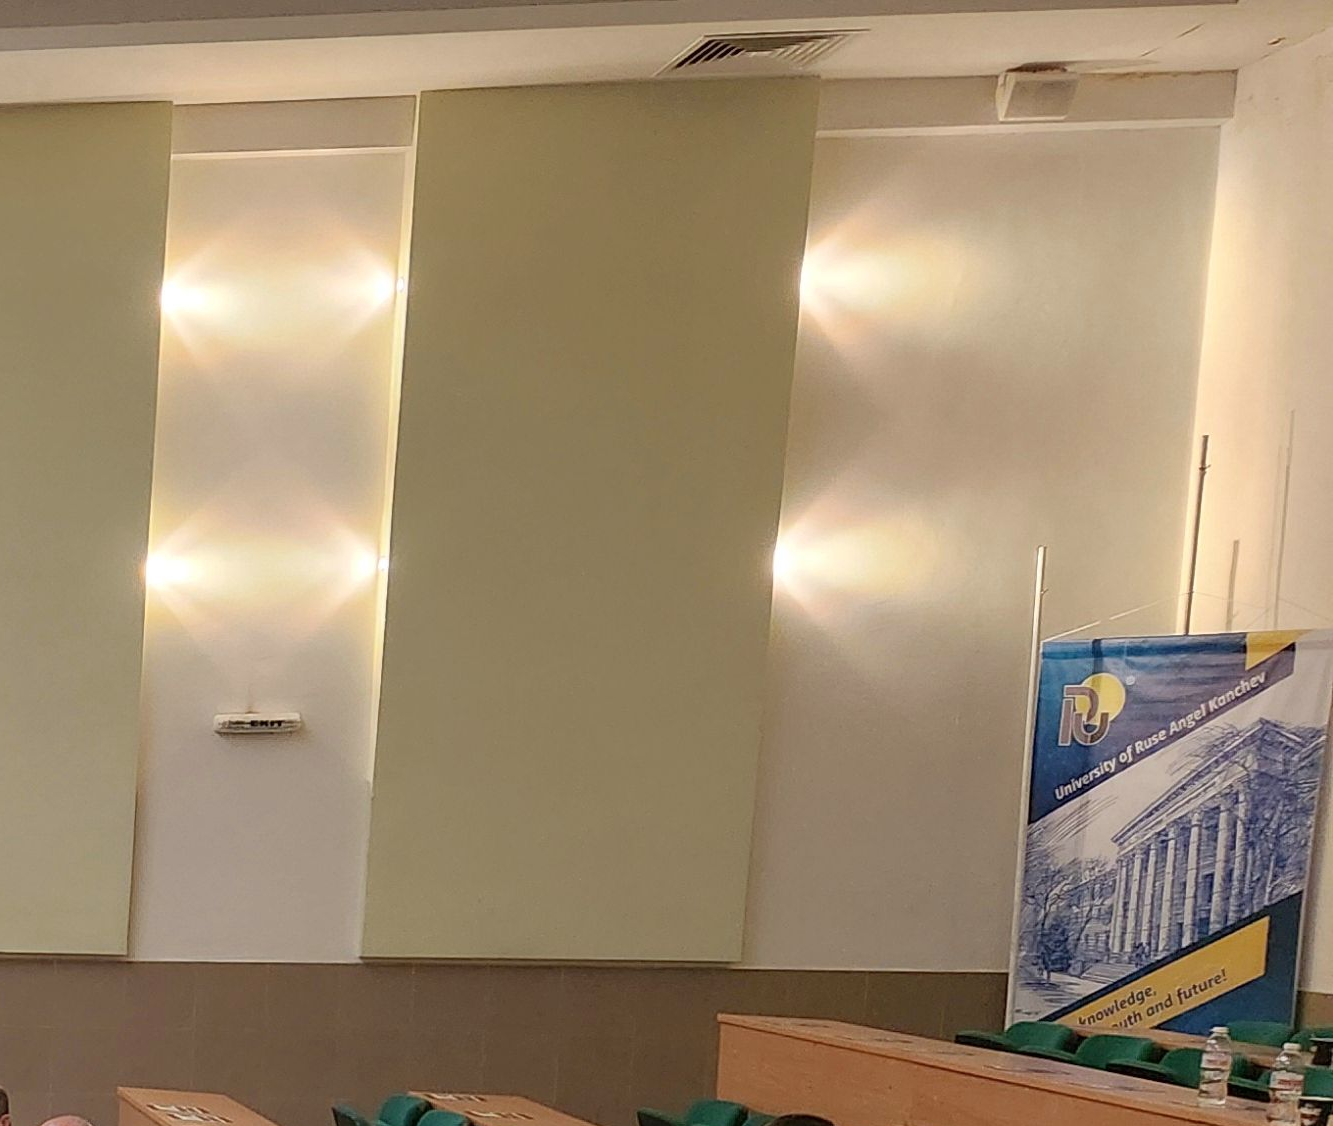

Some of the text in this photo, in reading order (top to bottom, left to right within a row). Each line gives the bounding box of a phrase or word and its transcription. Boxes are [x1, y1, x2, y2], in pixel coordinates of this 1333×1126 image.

[1053, 670, 1268, 802] University of Ruse Angel Kanchev
[1077, 984, 1158, 1026] knowledge,
[1146, 996, 1174, 1018] and
[1175, 969, 1229, 1006] future!
